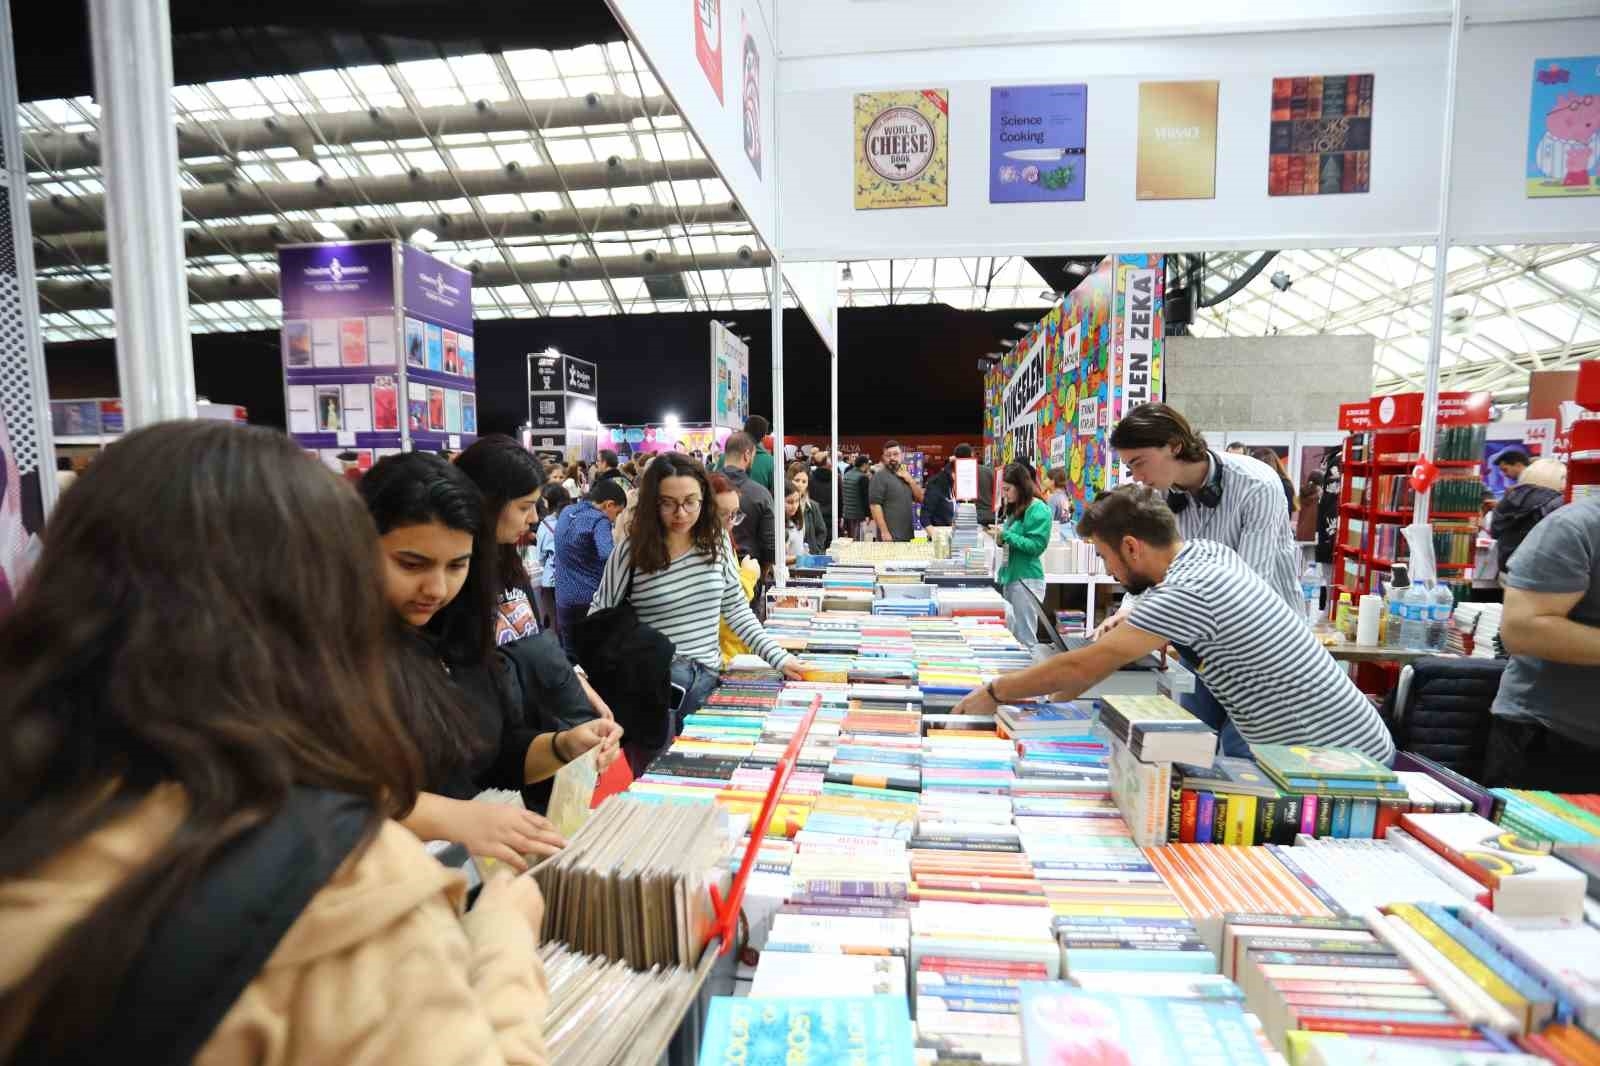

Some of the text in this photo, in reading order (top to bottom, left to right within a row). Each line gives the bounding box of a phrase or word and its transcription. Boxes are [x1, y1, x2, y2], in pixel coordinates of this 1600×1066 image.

[1000, 115, 1042, 126] Science
[884, 125, 917, 136] WORLD
[871, 133, 928, 156] CHEESE
[999, 131, 1045, 145] Cooking
[1130, 275, 1153, 340] ZEKA
